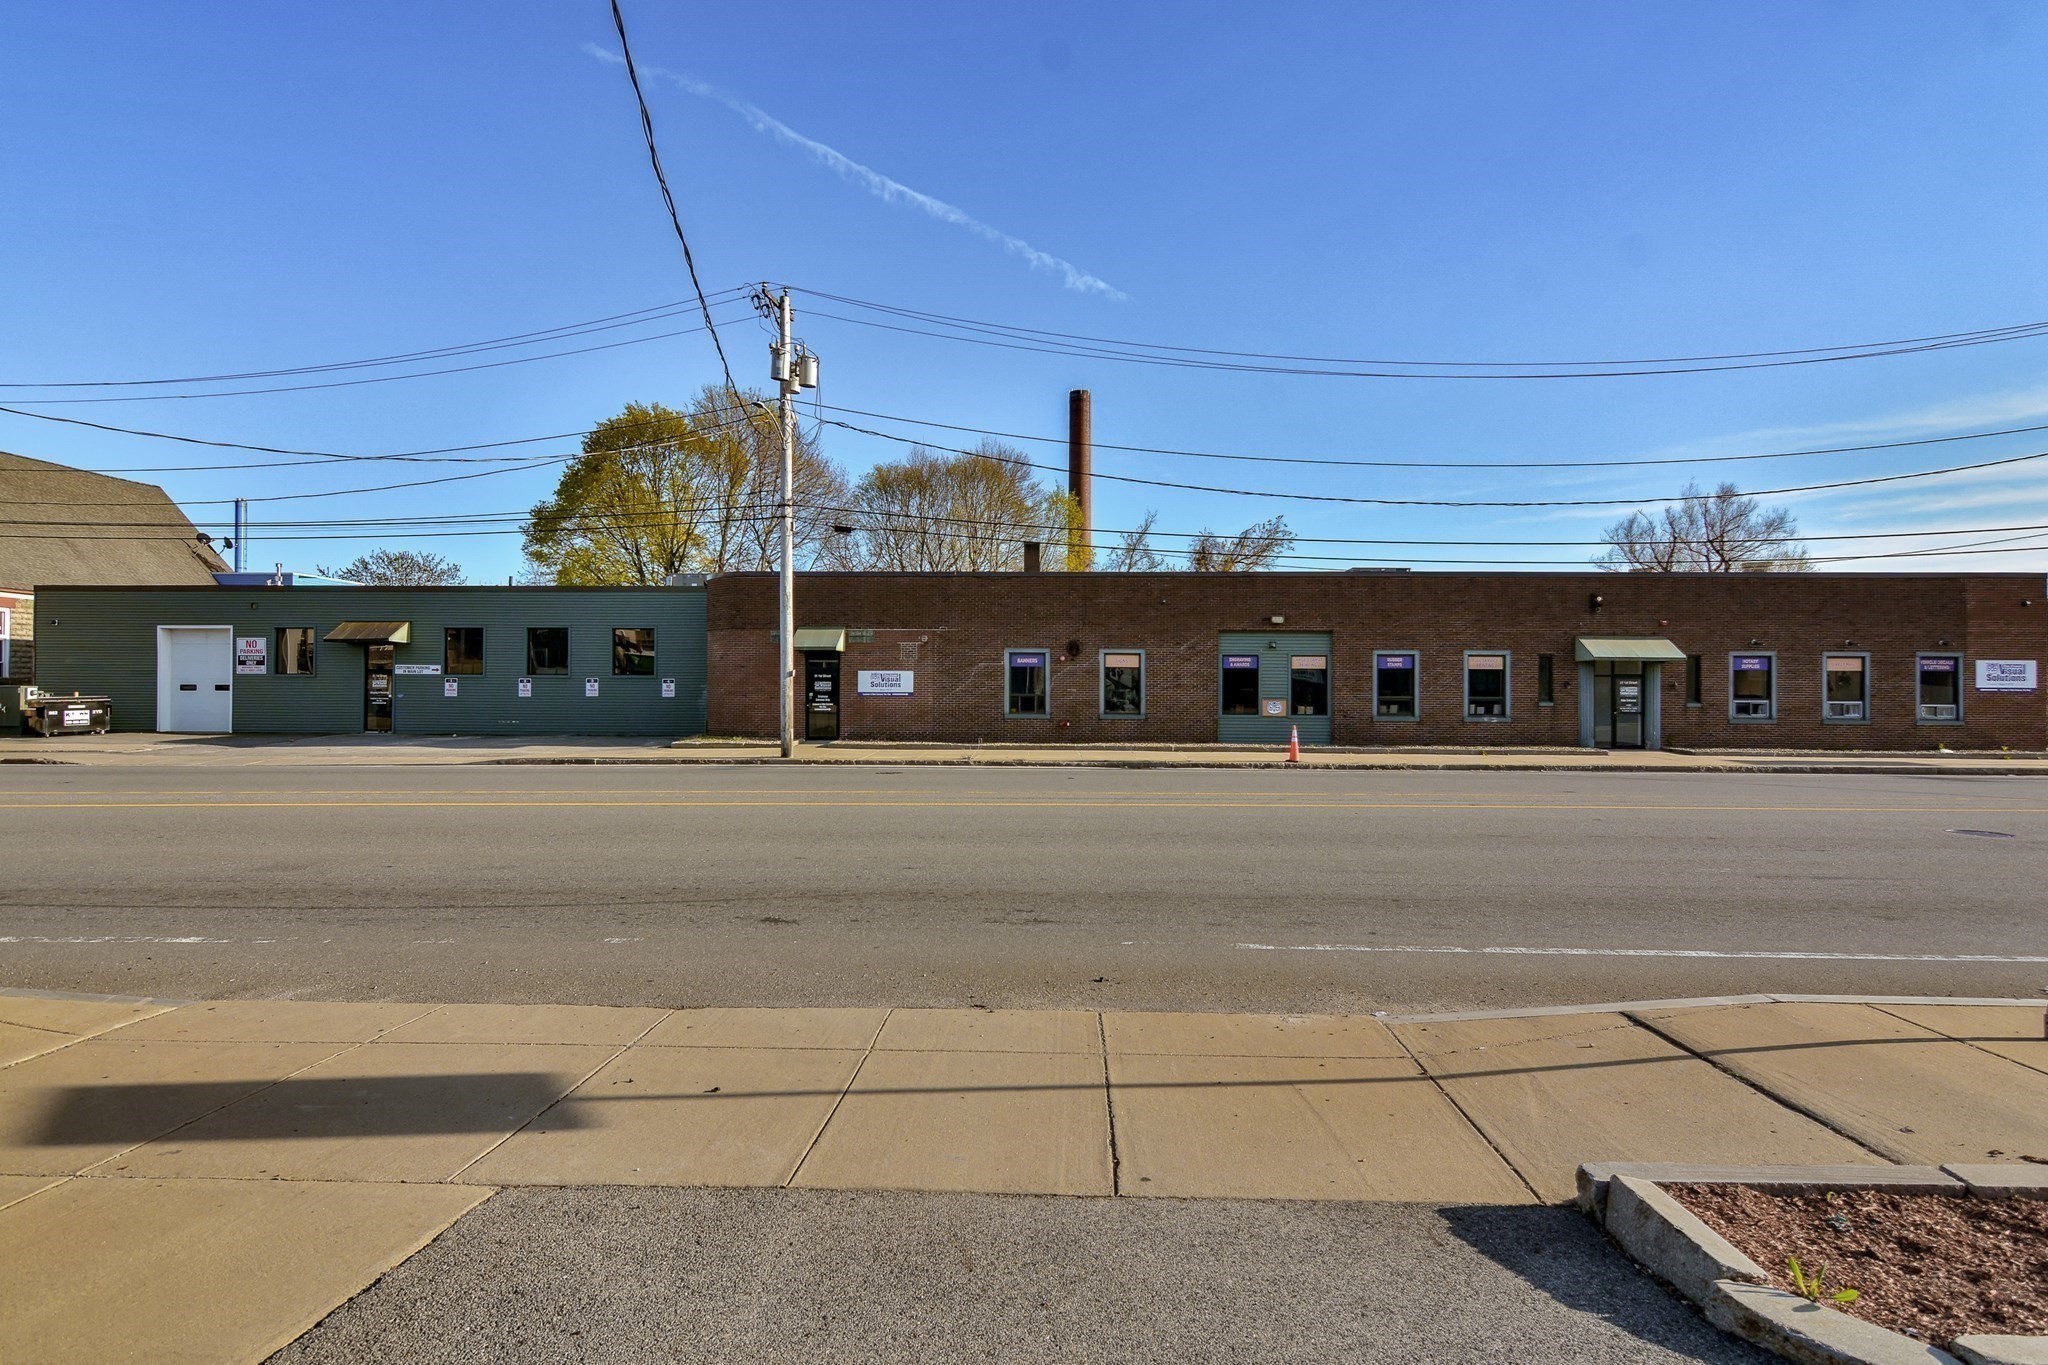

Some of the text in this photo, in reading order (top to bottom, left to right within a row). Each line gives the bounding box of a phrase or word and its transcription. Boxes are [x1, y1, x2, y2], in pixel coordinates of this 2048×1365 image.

[246, 640, 257, 648] NO
[1999, 664, 2026, 674] Visual
[880, 673, 901, 682] Visual
